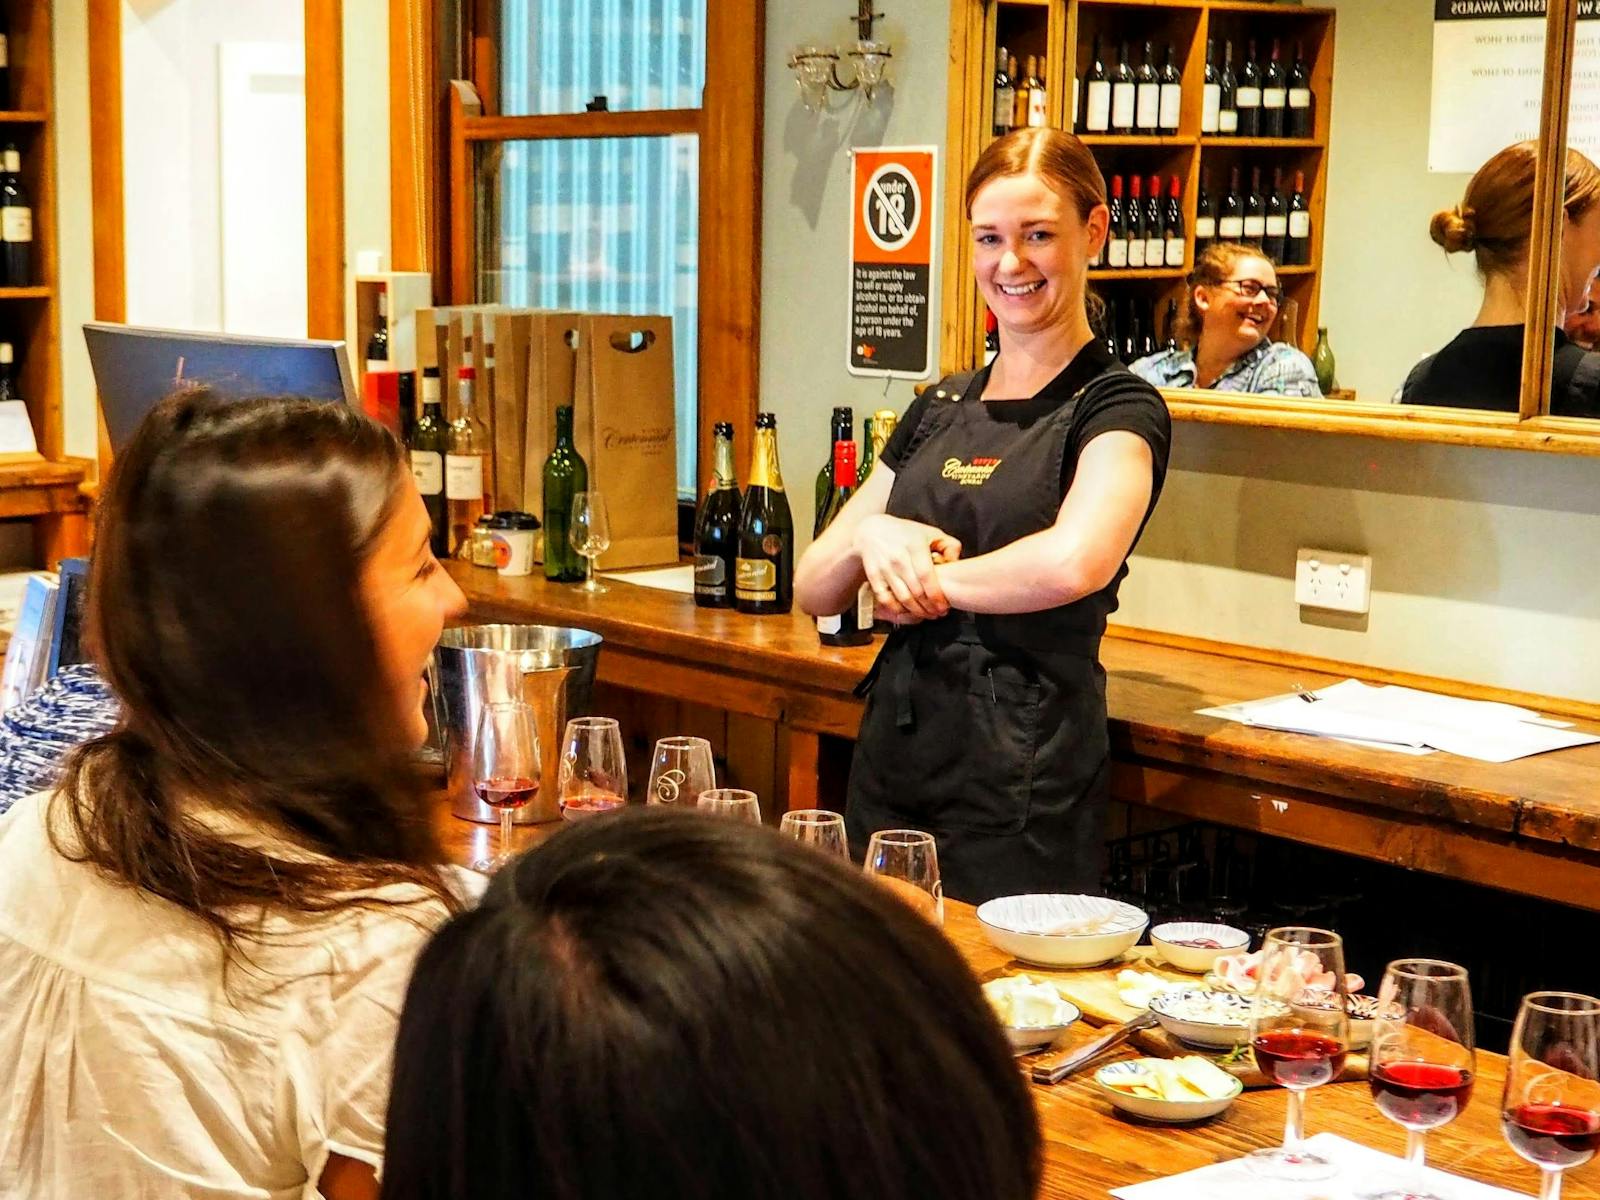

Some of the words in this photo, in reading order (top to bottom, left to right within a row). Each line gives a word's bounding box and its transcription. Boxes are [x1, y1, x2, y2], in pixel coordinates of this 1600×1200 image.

[875, 194, 906, 236] 18
[868, 269, 891, 281] against
[891, 269, 903, 280] the
[903, 269, 916, 280] law
[863, 280, 875, 290] sell
[882, 281, 904, 293] supply
[855, 292, 878, 302] alcohol
[904, 293, 926, 304] obtain
[855, 303, 878, 313] alcohol
[879, 304, 888, 314] on
[888, 304, 909, 315] behalf
[860, 315, 883, 326] person
[883, 315, 902, 326] under
[902, 316, 914, 327] the
[854, 327, 866, 338] age
